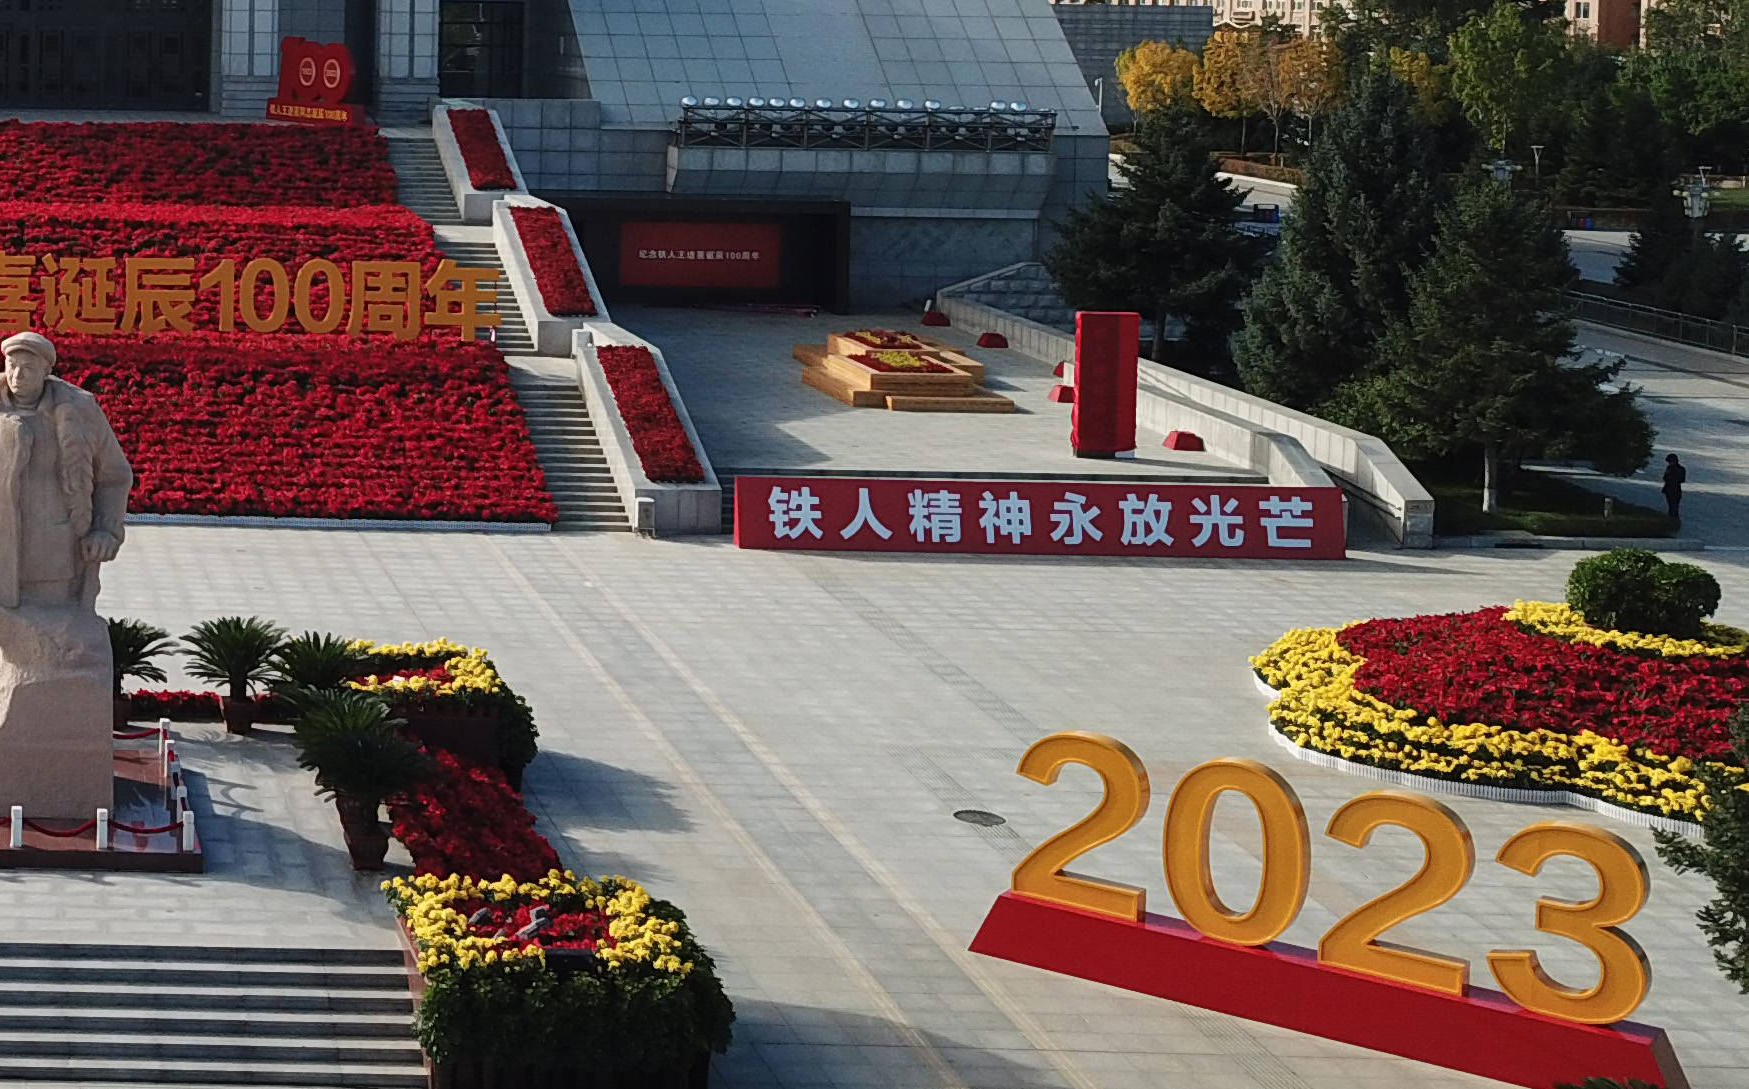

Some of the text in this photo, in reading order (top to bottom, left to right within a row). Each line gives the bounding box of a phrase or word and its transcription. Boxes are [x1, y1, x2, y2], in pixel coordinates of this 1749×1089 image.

[768, 485, 1315, 550] 铁人精神永放光芒
[1011, 730, 1652, 1025] 2023
